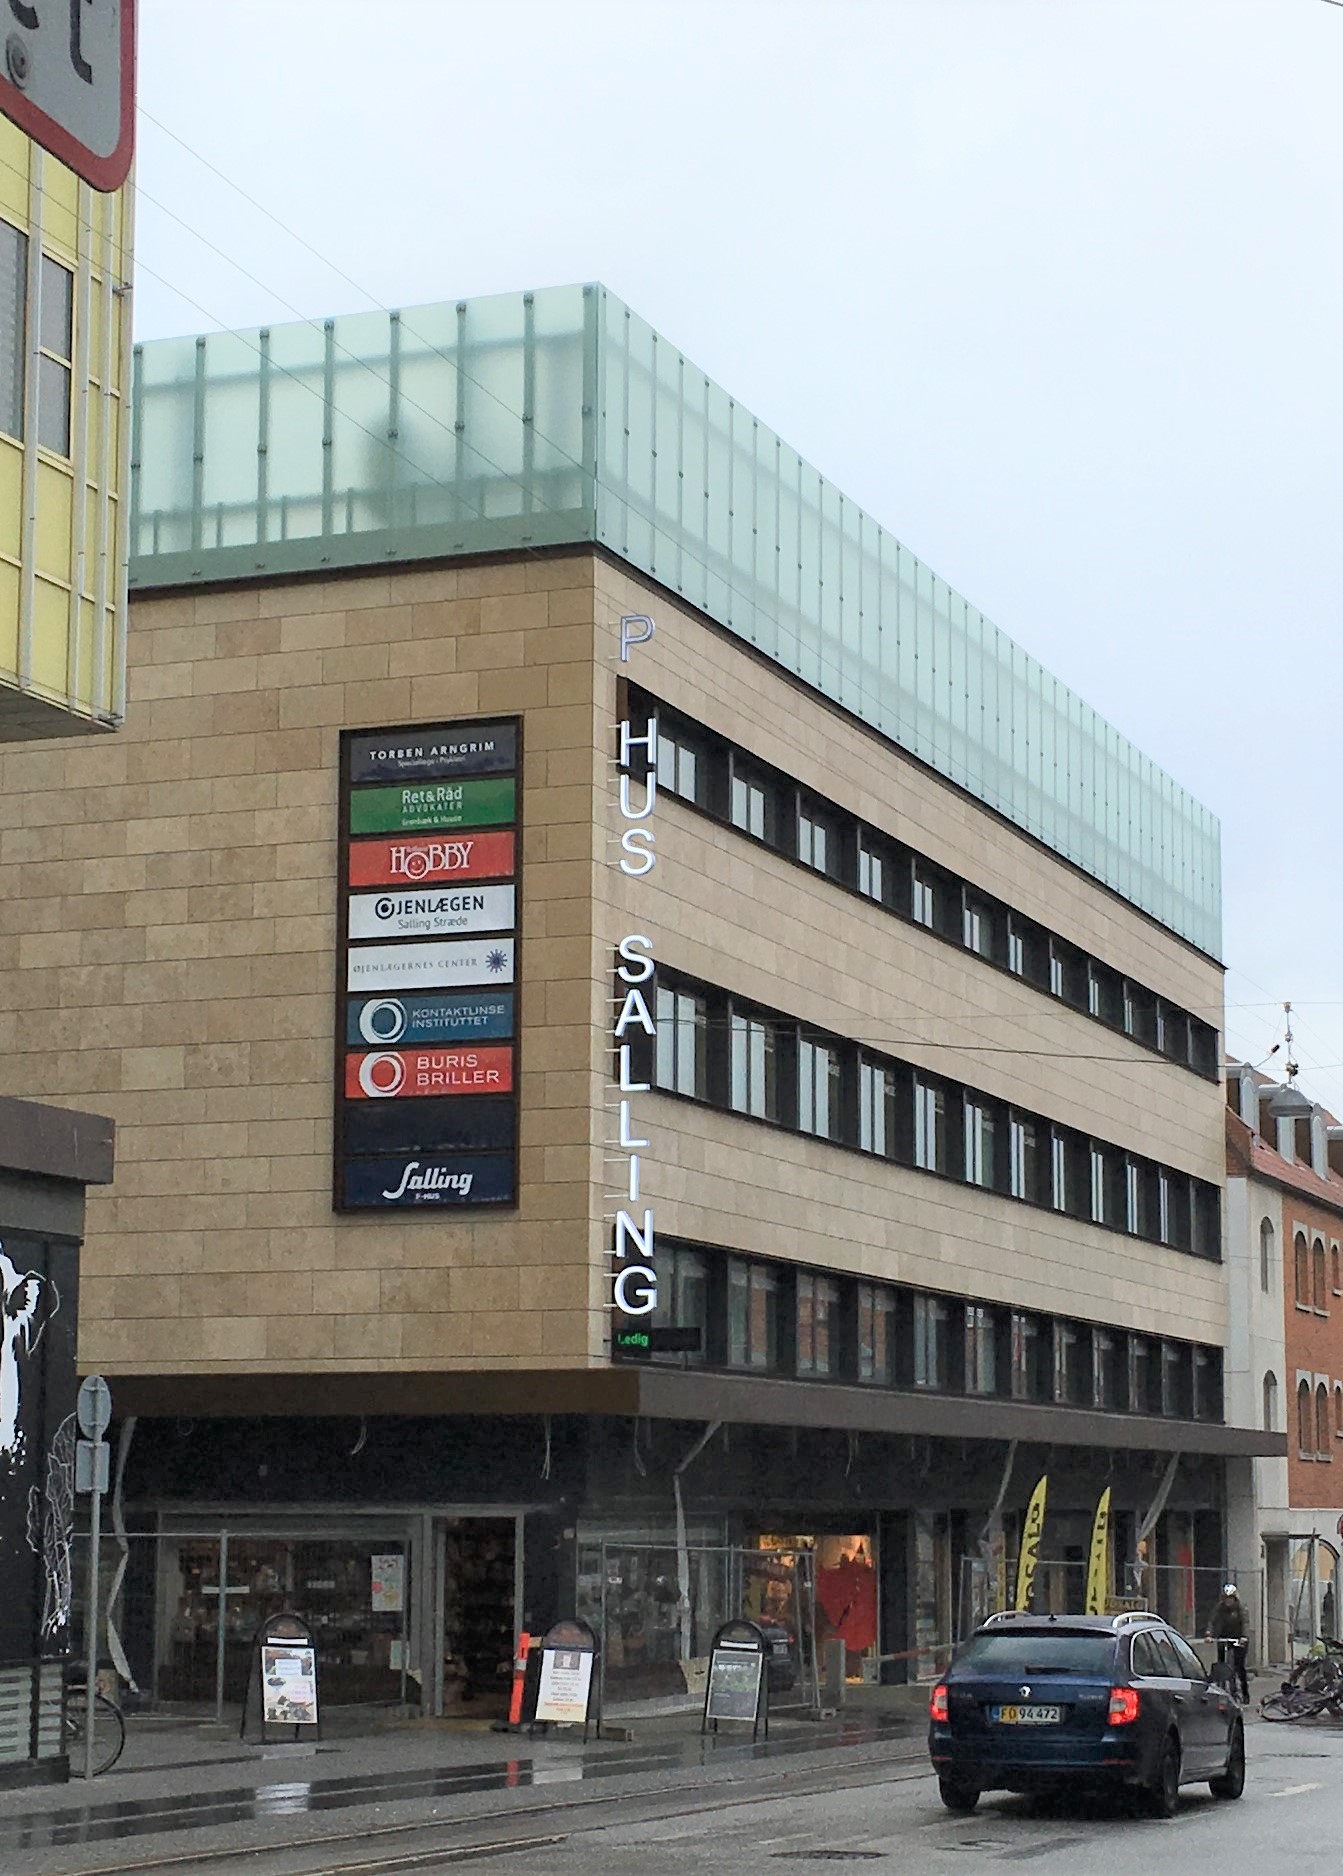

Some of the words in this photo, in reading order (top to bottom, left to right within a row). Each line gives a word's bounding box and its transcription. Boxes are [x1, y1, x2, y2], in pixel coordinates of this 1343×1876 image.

[619, 614, 656, 663] P
[370, 748, 423, 760] TORBEN
[430, 741, 495, 756] ARNGRIM
[402, 786, 463, 804] Ret&Råd
[618, 718, 656, 877] HUS
[402, 801, 463, 813] ADVOKATER
[390, 842, 474, 879] HOBBY
[398, 919, 431, 930] Salling
[434, 916, 468, 928] Stræde
[353, 962, 434, 974] ØJENLÆGERNES
[438, 958, 478, 968] CENTER
[412, 1005, 505, 1018] KONTAKTLINSE
[412, 1016, 488, 1028] INSTITUTTET
[417, 1054, 477, 1070] BURIS
[417, 1070, 499, 1086] BRILLER
[614, 934, 657, 1315] SALLING
[382, 1161, 473, 1200] Salling
[618, 1333, 649, 1347] Ledig
[1019, 1706, 1034, 1720] 94
[1036, 1706, 1058, 1720] 472
